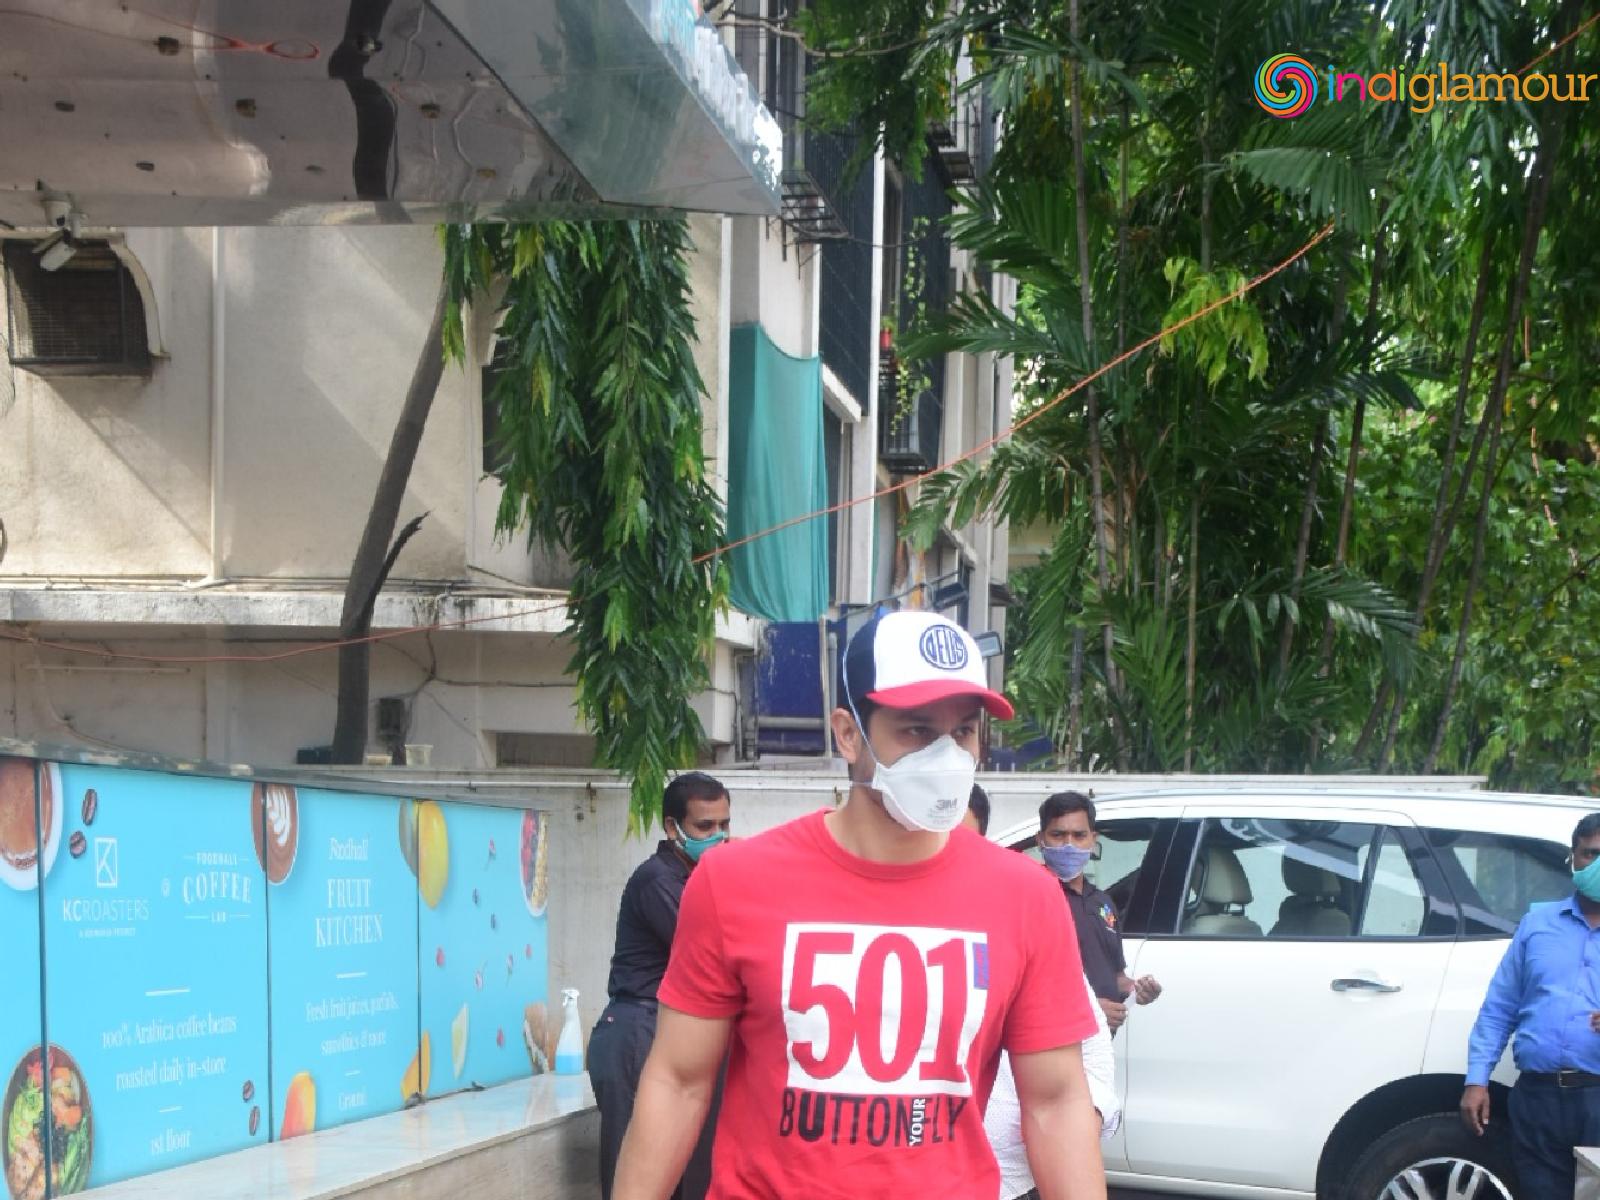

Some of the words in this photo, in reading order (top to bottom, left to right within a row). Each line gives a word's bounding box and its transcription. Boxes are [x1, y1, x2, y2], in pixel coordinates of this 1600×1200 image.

[183, 872, 252, 905] COFFEE
[327, 879, 371, 908] FRUIT
[315, 913, 383, 948] KITCHEN
[788, 932, 967, 1083] 501
[176, 1014, 207, 1040] coffee
[208, 1012, 237, 1035] beans
[116, 1060, 158, 1091] roasted
[160, 1055, 184, 1085] daily
[909, 1098, 926, 1146] YOUR
